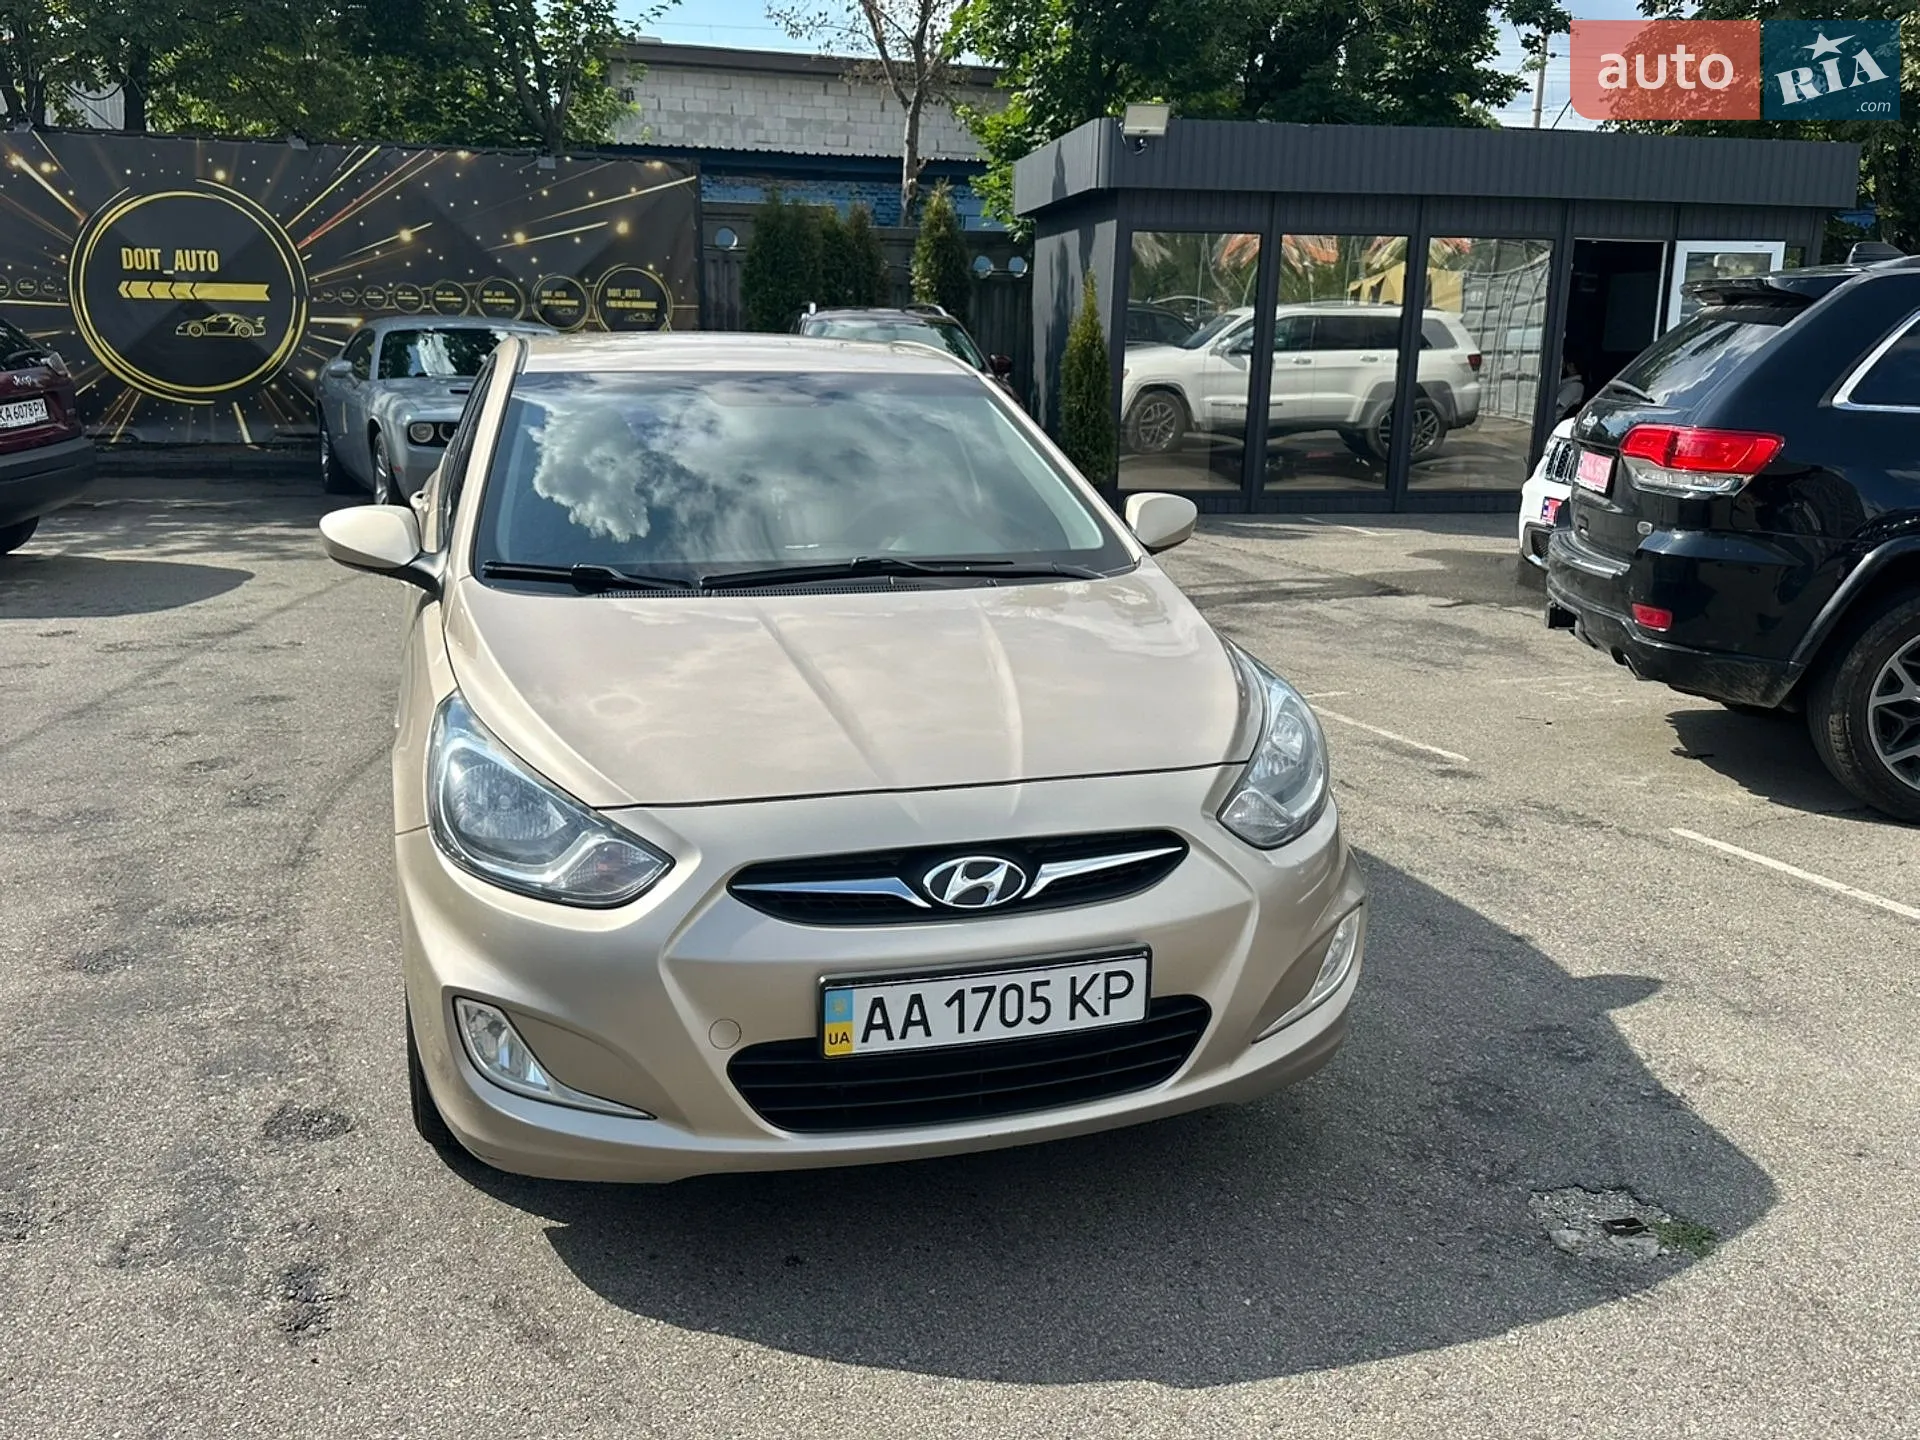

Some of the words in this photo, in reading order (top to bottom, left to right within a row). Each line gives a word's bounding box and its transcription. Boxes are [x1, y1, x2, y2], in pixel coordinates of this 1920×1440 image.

[121, 247, 219, 274] DOIT_AUTO
[861, 992, 932, 1044] AA
[944, 980, 1051, 1034] 1705
[1068, 970, 1135, 1021] KP
[828, 1031, 850, 1046] UA
